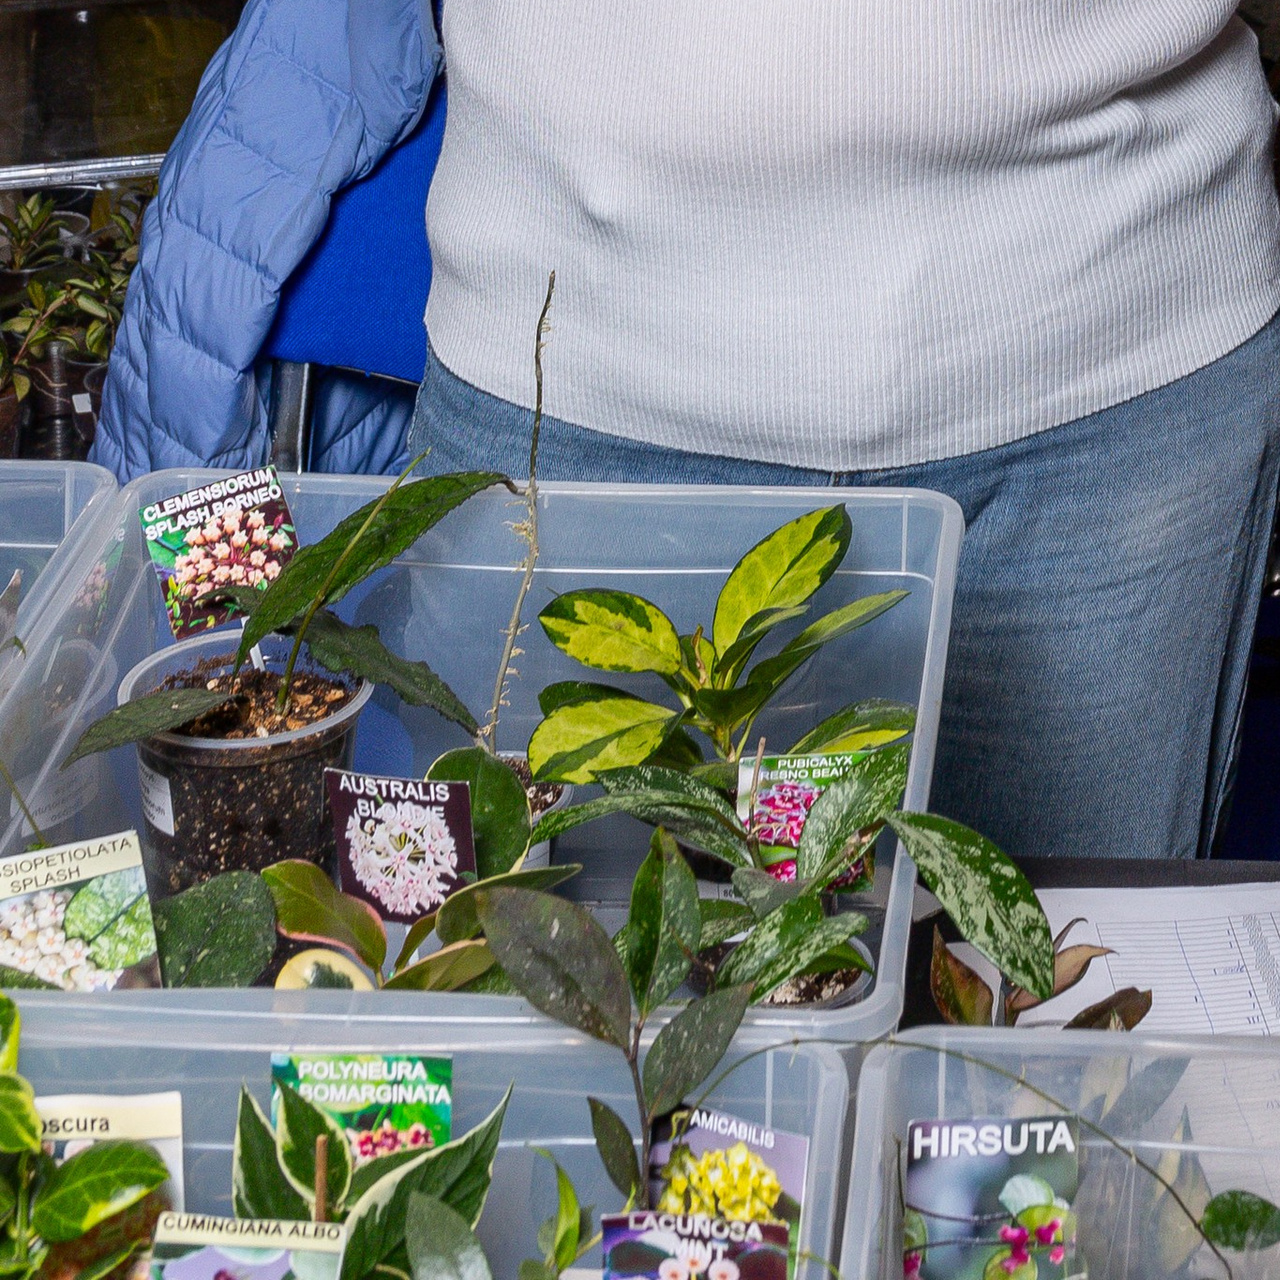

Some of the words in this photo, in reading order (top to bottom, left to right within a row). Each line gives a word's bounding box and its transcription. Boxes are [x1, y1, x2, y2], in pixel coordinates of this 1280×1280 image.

[143, 467, 273, 522] CLEMENSIORUM
[145, 507, 210, 540] SPLASH
[212, 484, 282, 518] BORNEO
[757, 769, 808, 781] RESNO
[777, 755, 853, 770] PUBICALYX
[340, 773, 450, 802] AUSTRALIS
[10, 866, 80, 894] SPLASH
[298, 1060, 427, 1081] POLYNEURA
[272, 1083, 452, 1105] BOMARGINATA
[690, 1109, 775, 1149] AMICABILIS
[913, 1120, 1076, 1159] HIRSUTA
[163, 1216, 283, 1236] CUMINGIANA
[289, 1223, 341, 1240] ALBO
[628, 1212, 763, 1242] LACUNOSA
[675, 1238, 729, 1262] MINT
